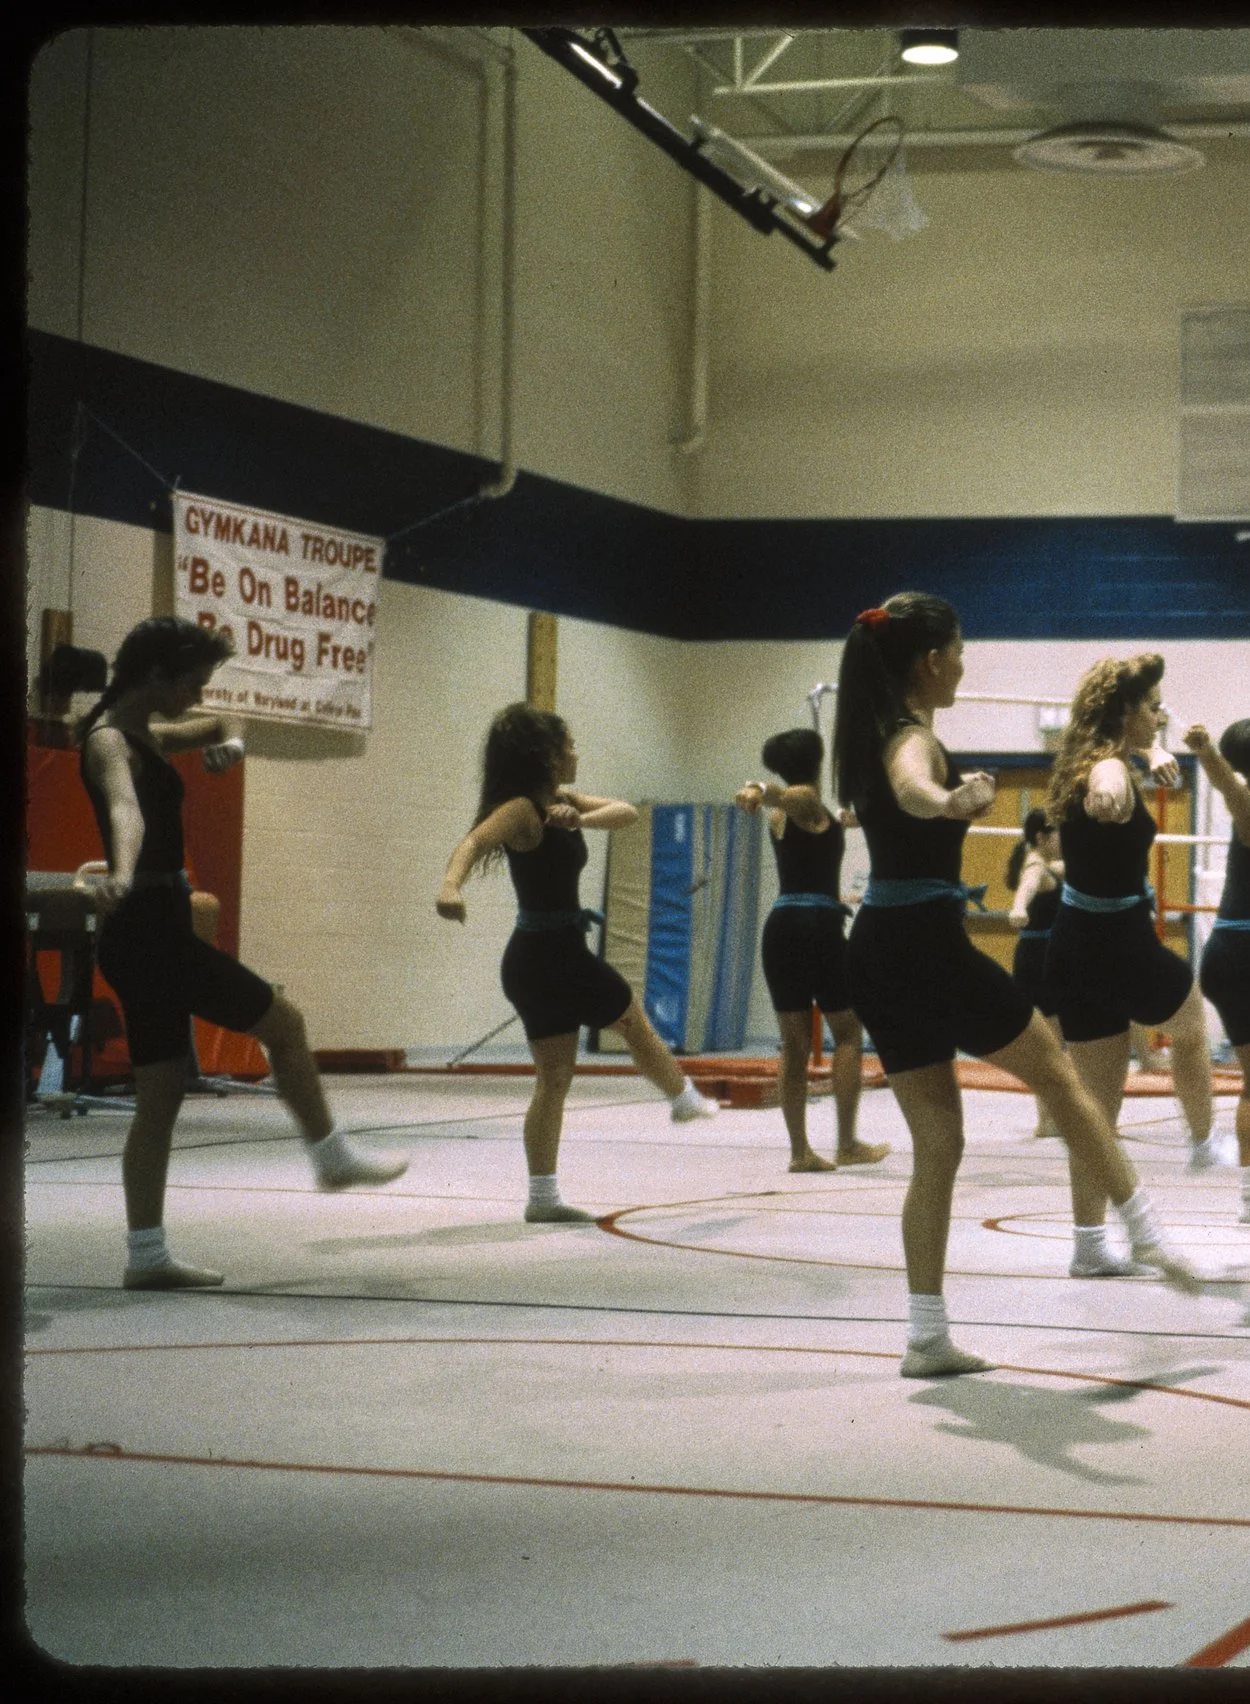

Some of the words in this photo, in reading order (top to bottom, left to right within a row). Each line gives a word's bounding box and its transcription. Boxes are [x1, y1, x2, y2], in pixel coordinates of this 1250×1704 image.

[185, 505, 289, 556] GYMKANA
[301, 533, 377, 573] TROUPE
[239, 567, 272, 607] On
[285, 576, 375, 627] Balance
[247, 621, 305, 671] Drug
